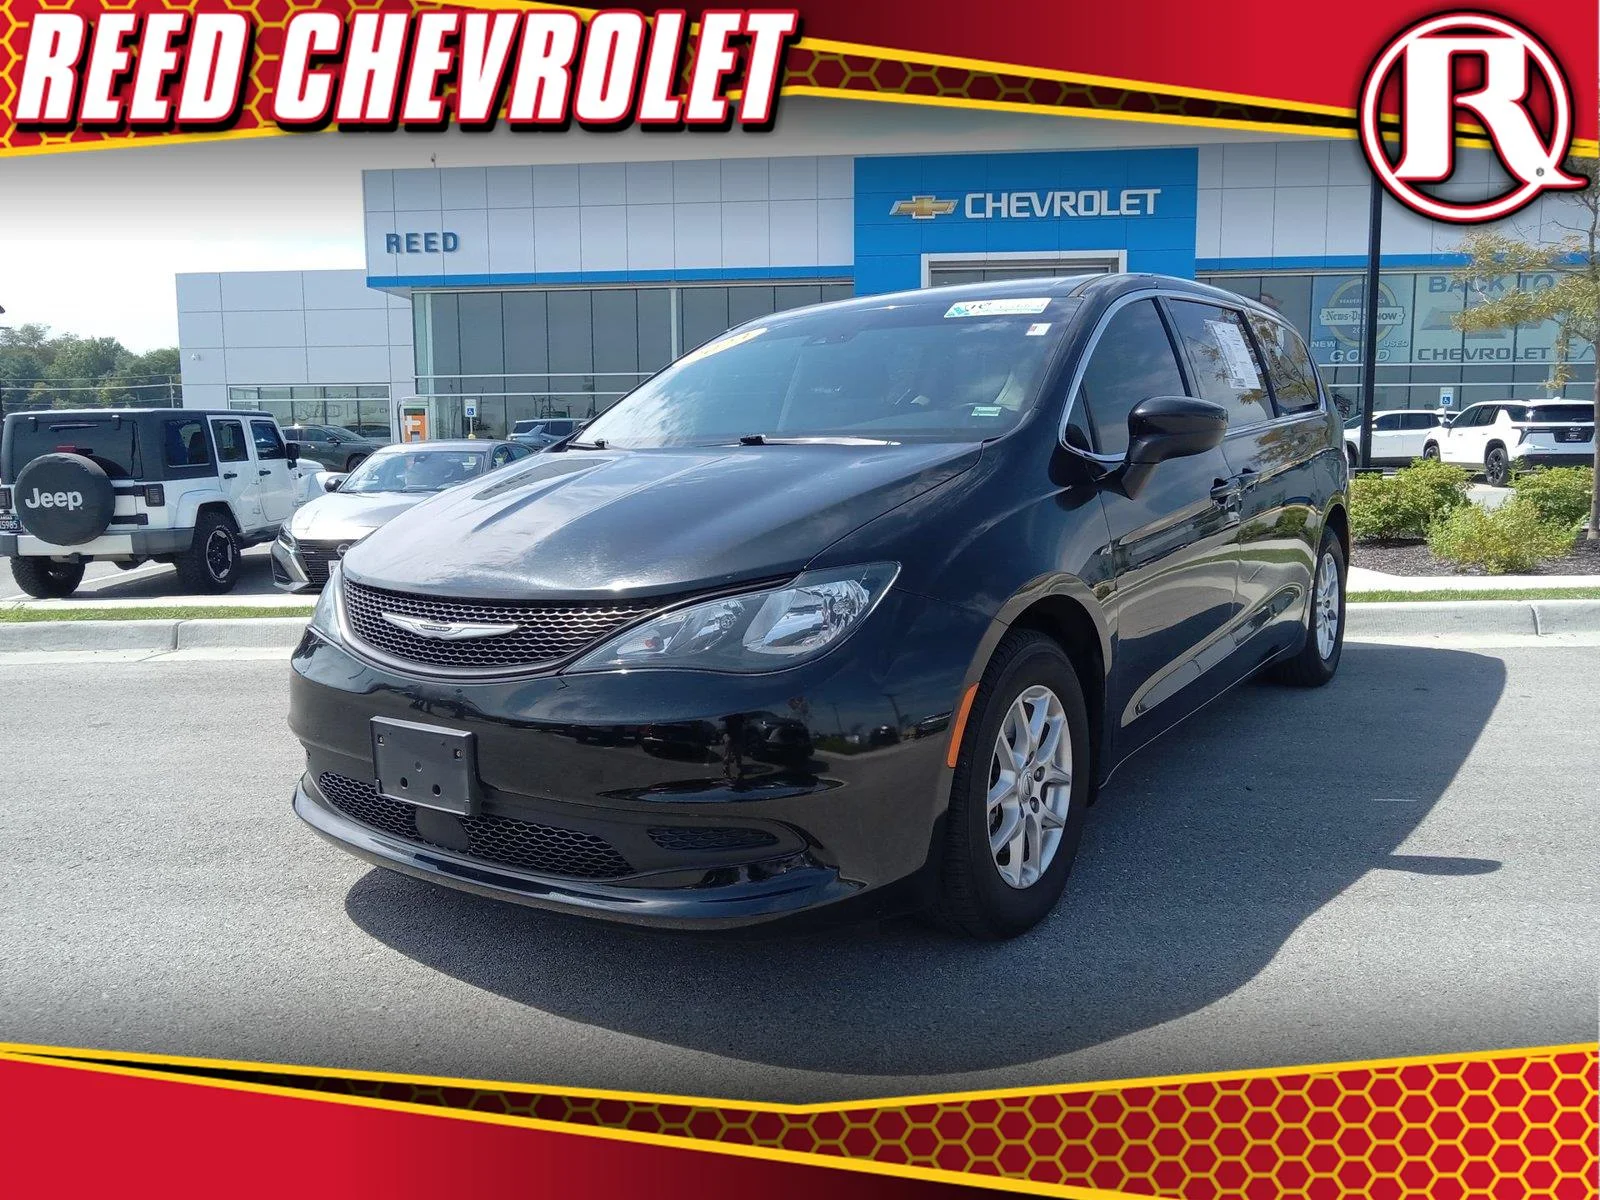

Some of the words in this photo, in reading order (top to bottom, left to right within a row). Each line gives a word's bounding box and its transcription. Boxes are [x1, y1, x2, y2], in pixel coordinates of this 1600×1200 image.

[964, 188, 1162, 219] CHEVROLET
[385, 231, 459, 254] REED
[1428, 276, 1505, 294] BACK
[1518, 274, 1554, 293] TO
[1383, 340, 1409, 348] USED
[1329, 349, 1391, 362] GOD
[1417, 348, 1551, 361] CHEVROLET
[25, 487, 83, 511] Jeep
